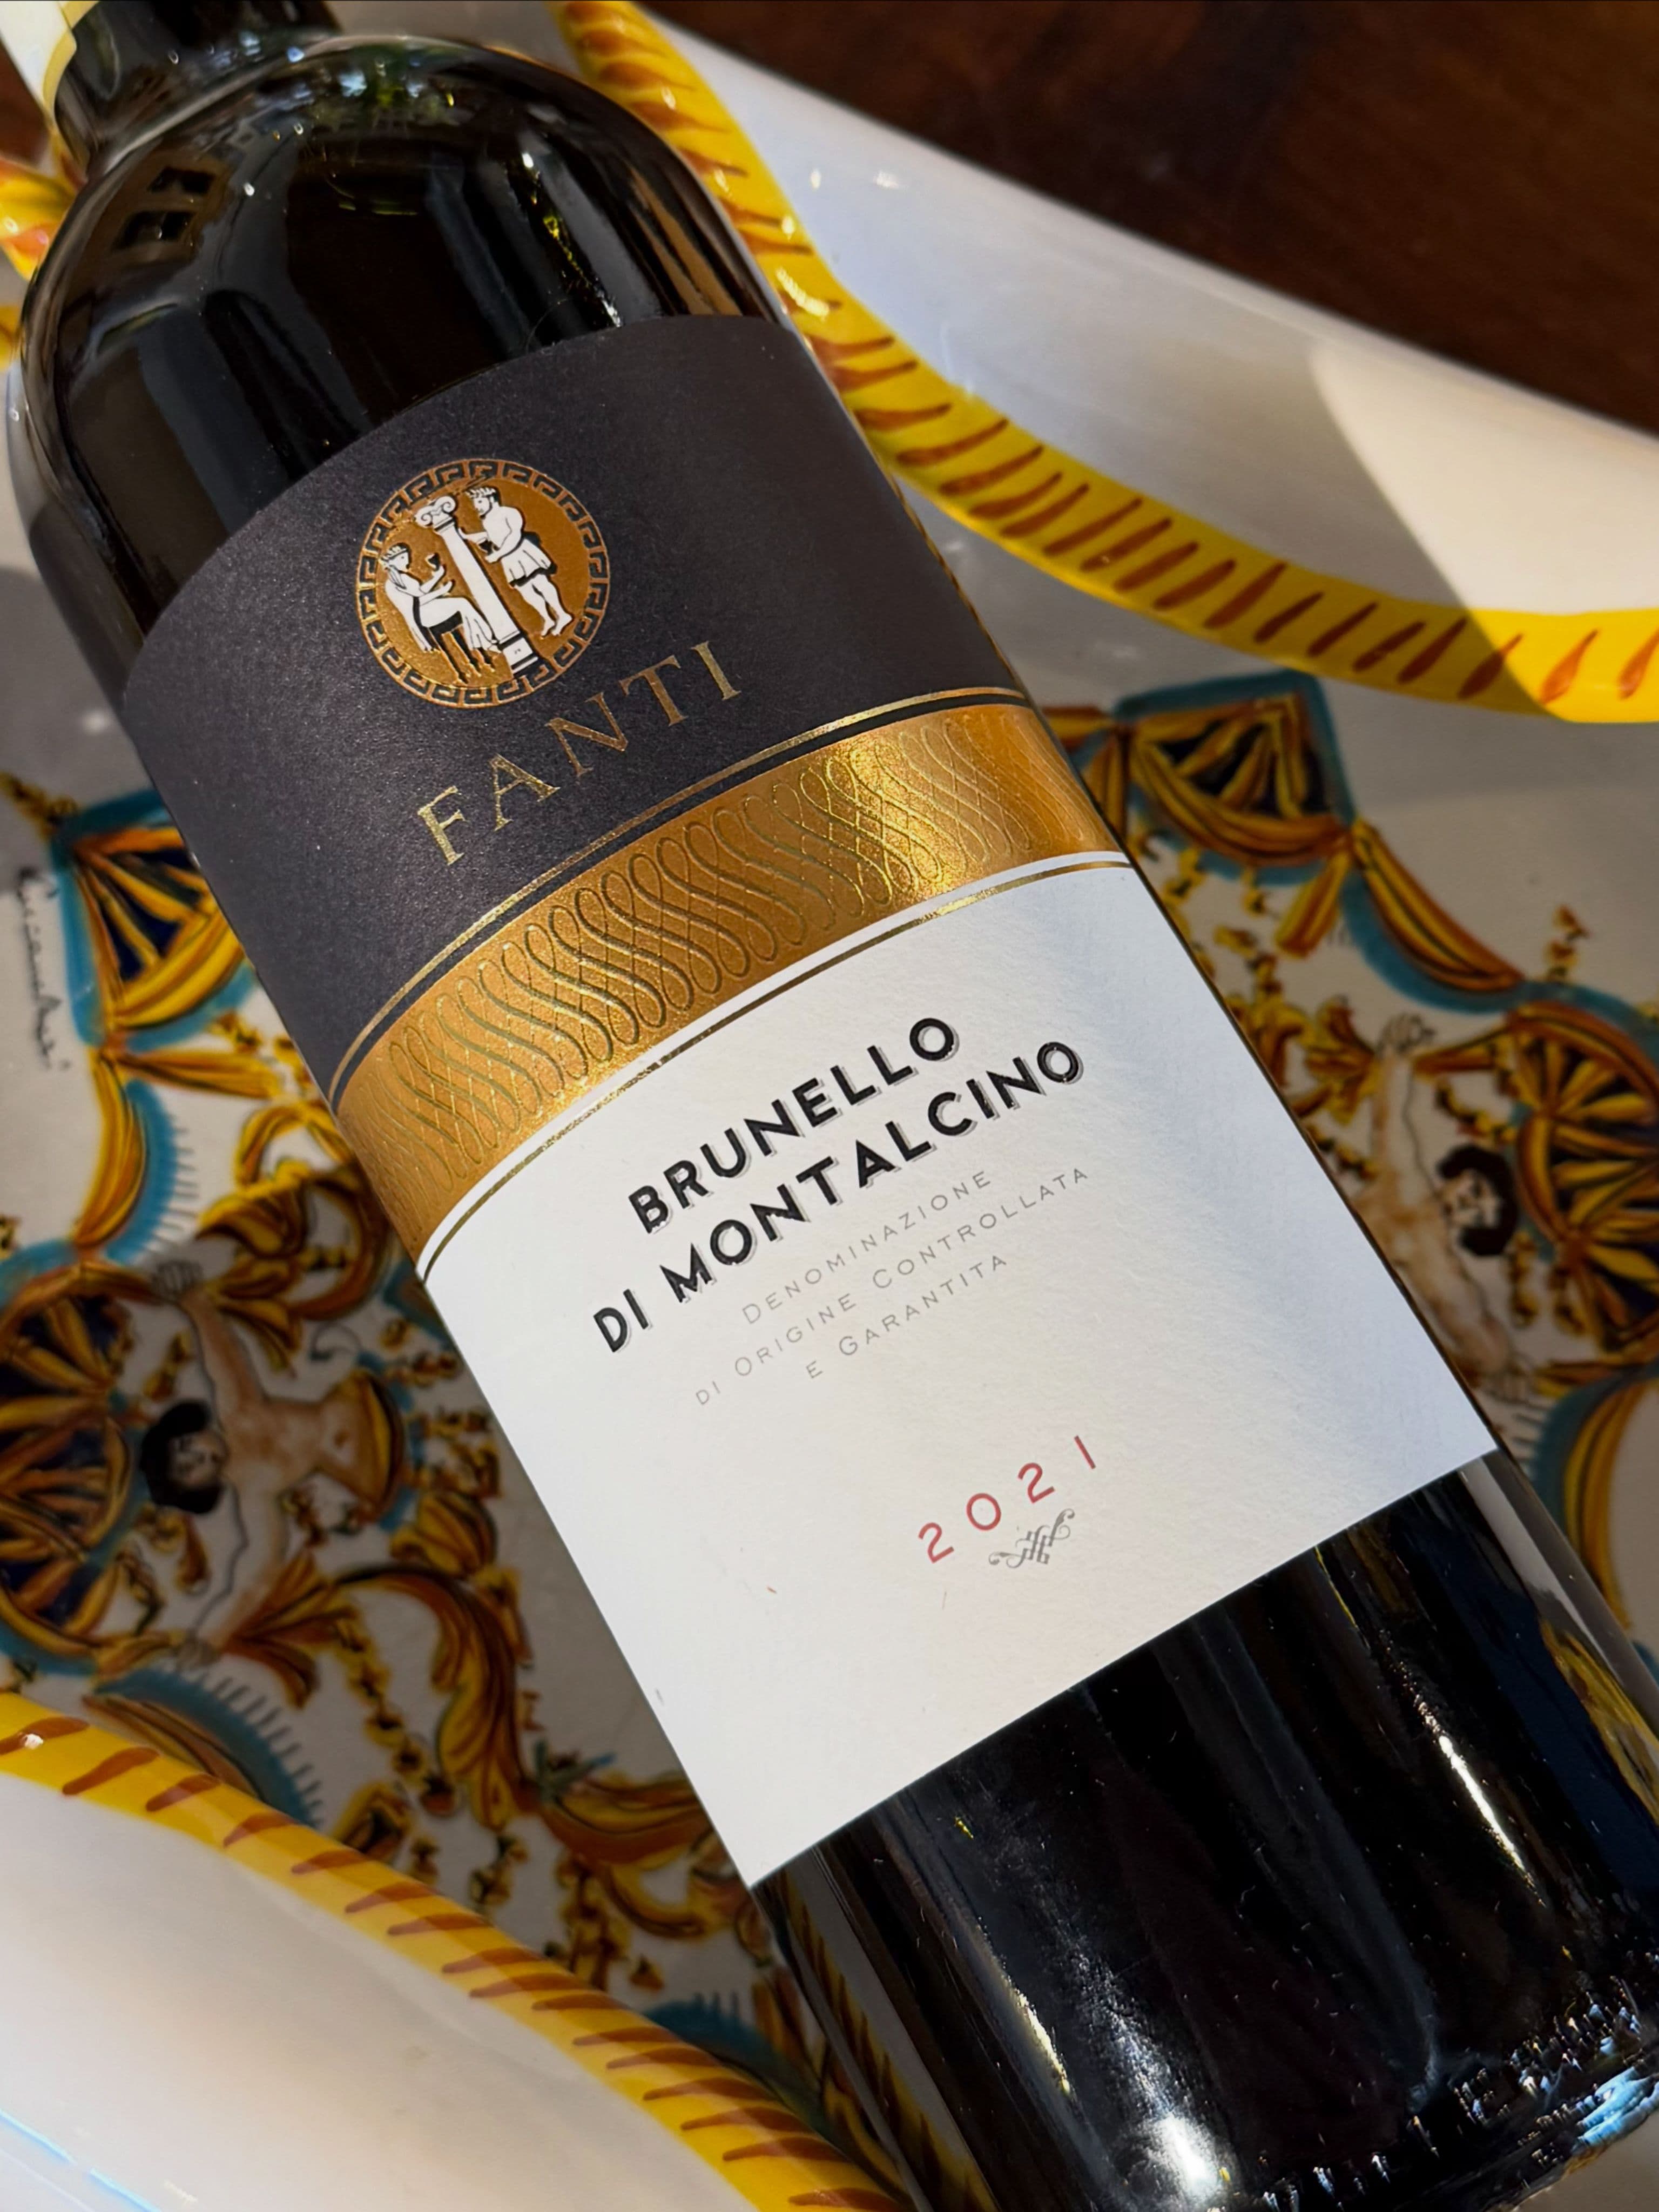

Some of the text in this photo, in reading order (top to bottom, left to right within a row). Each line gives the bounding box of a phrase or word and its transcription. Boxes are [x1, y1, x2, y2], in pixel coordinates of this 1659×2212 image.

[417, 641, 740, 865] FANTI
[594, 1042, 1084, 1352] DI MONTALCINO
[629, 1018, 960, 1233] BRUNELLO
[743, 1171, 991, 1324] DENOMINAZIONE
[918, 1435, 1097, 1563] 2021
